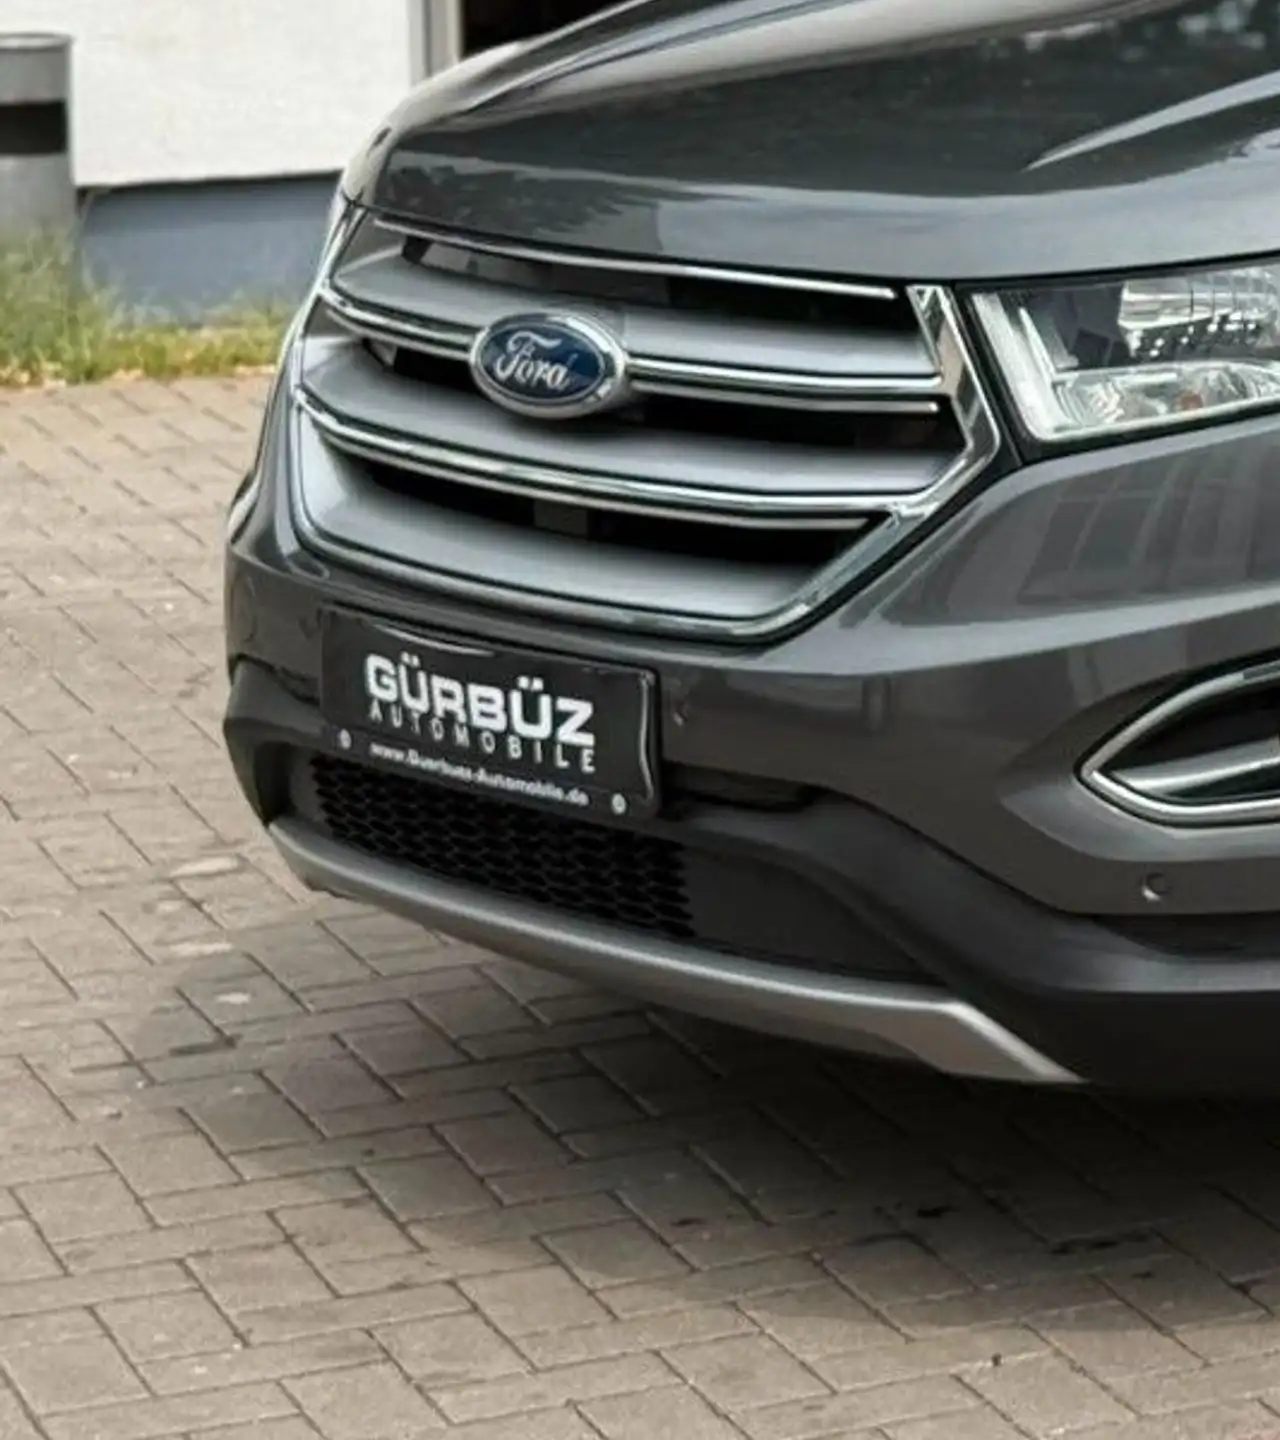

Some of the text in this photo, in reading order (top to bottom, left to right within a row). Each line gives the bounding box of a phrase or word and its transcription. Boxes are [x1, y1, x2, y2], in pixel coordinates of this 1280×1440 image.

[496, 331, 577, 391] Ford
[366, 652, 595, 746] GÜRBÜZ
[369, 701, 596, 773] AUTOMOBILE
